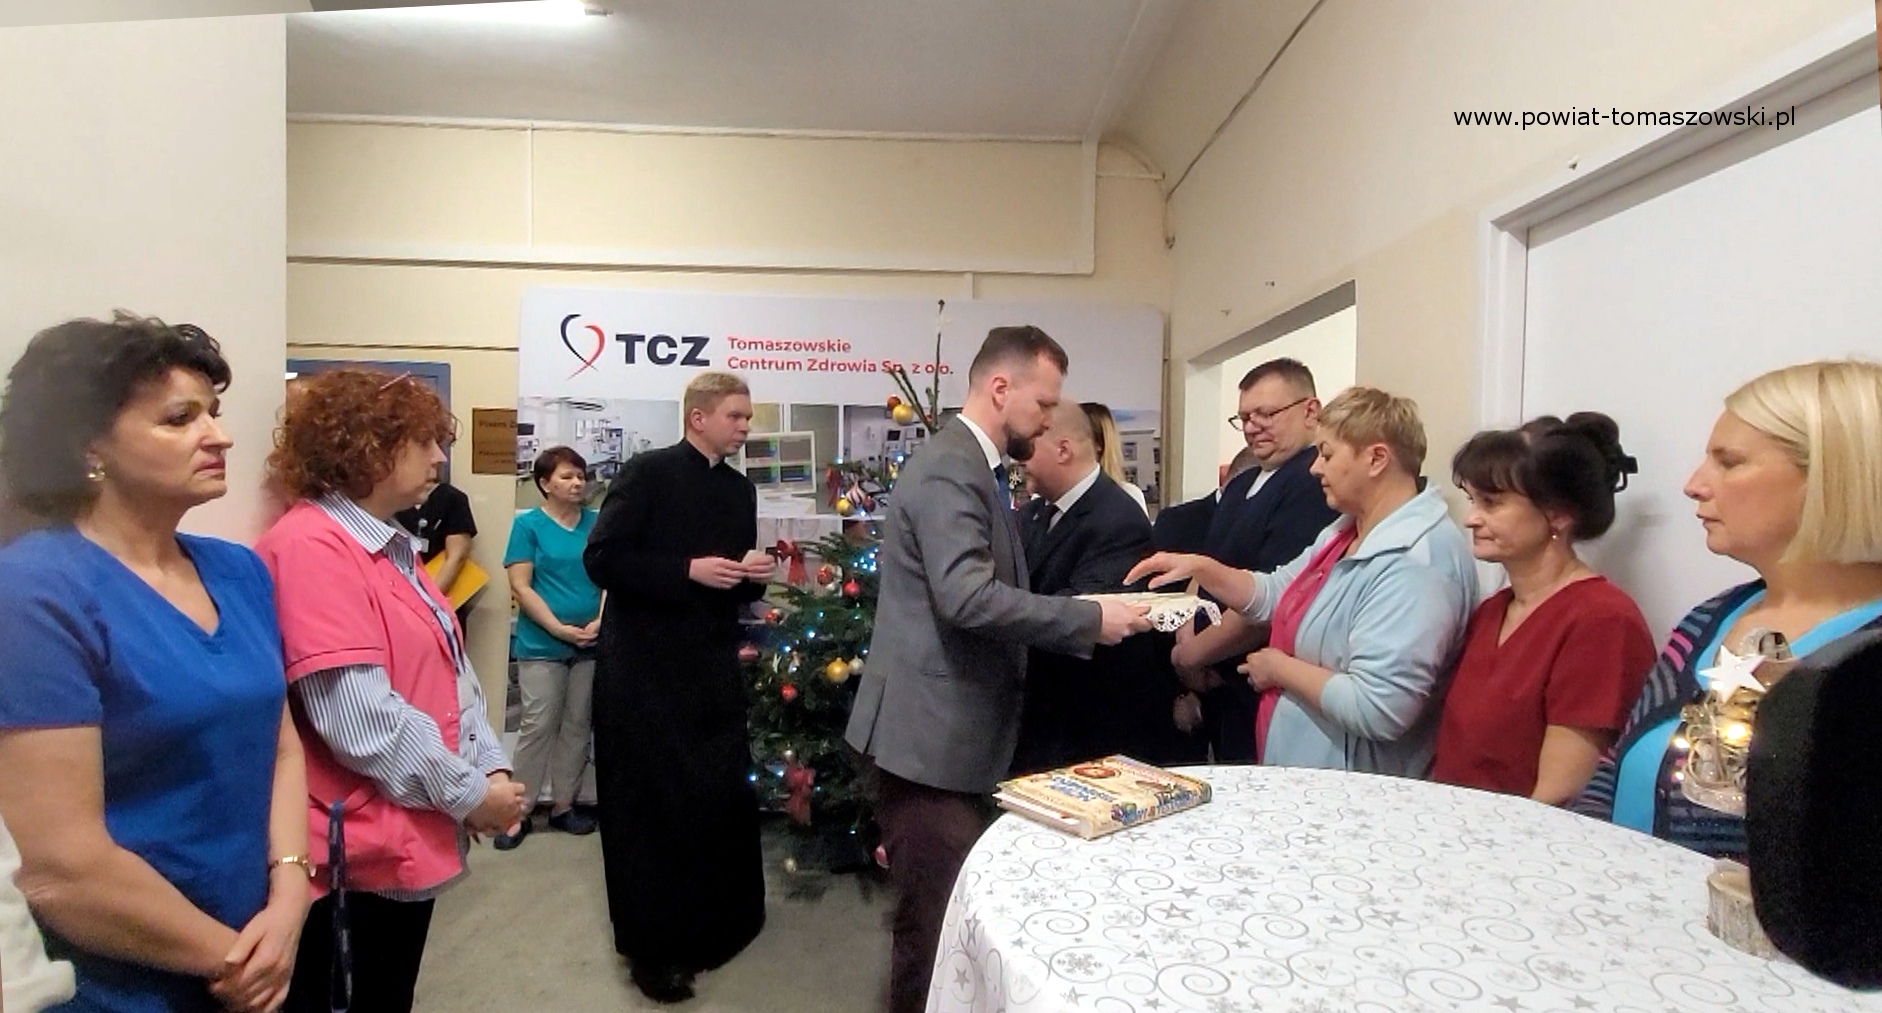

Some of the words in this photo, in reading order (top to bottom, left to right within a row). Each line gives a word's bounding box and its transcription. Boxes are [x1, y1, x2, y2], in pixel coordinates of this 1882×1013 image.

[615, 333, 710, 367] TCZ
[727, 336, 852, 353] Tomaszowskie
[727, 356, 803, 371] Centrum
[807, 358, 877, 373] Zdrowia
[911, 363, 921, 374] z
